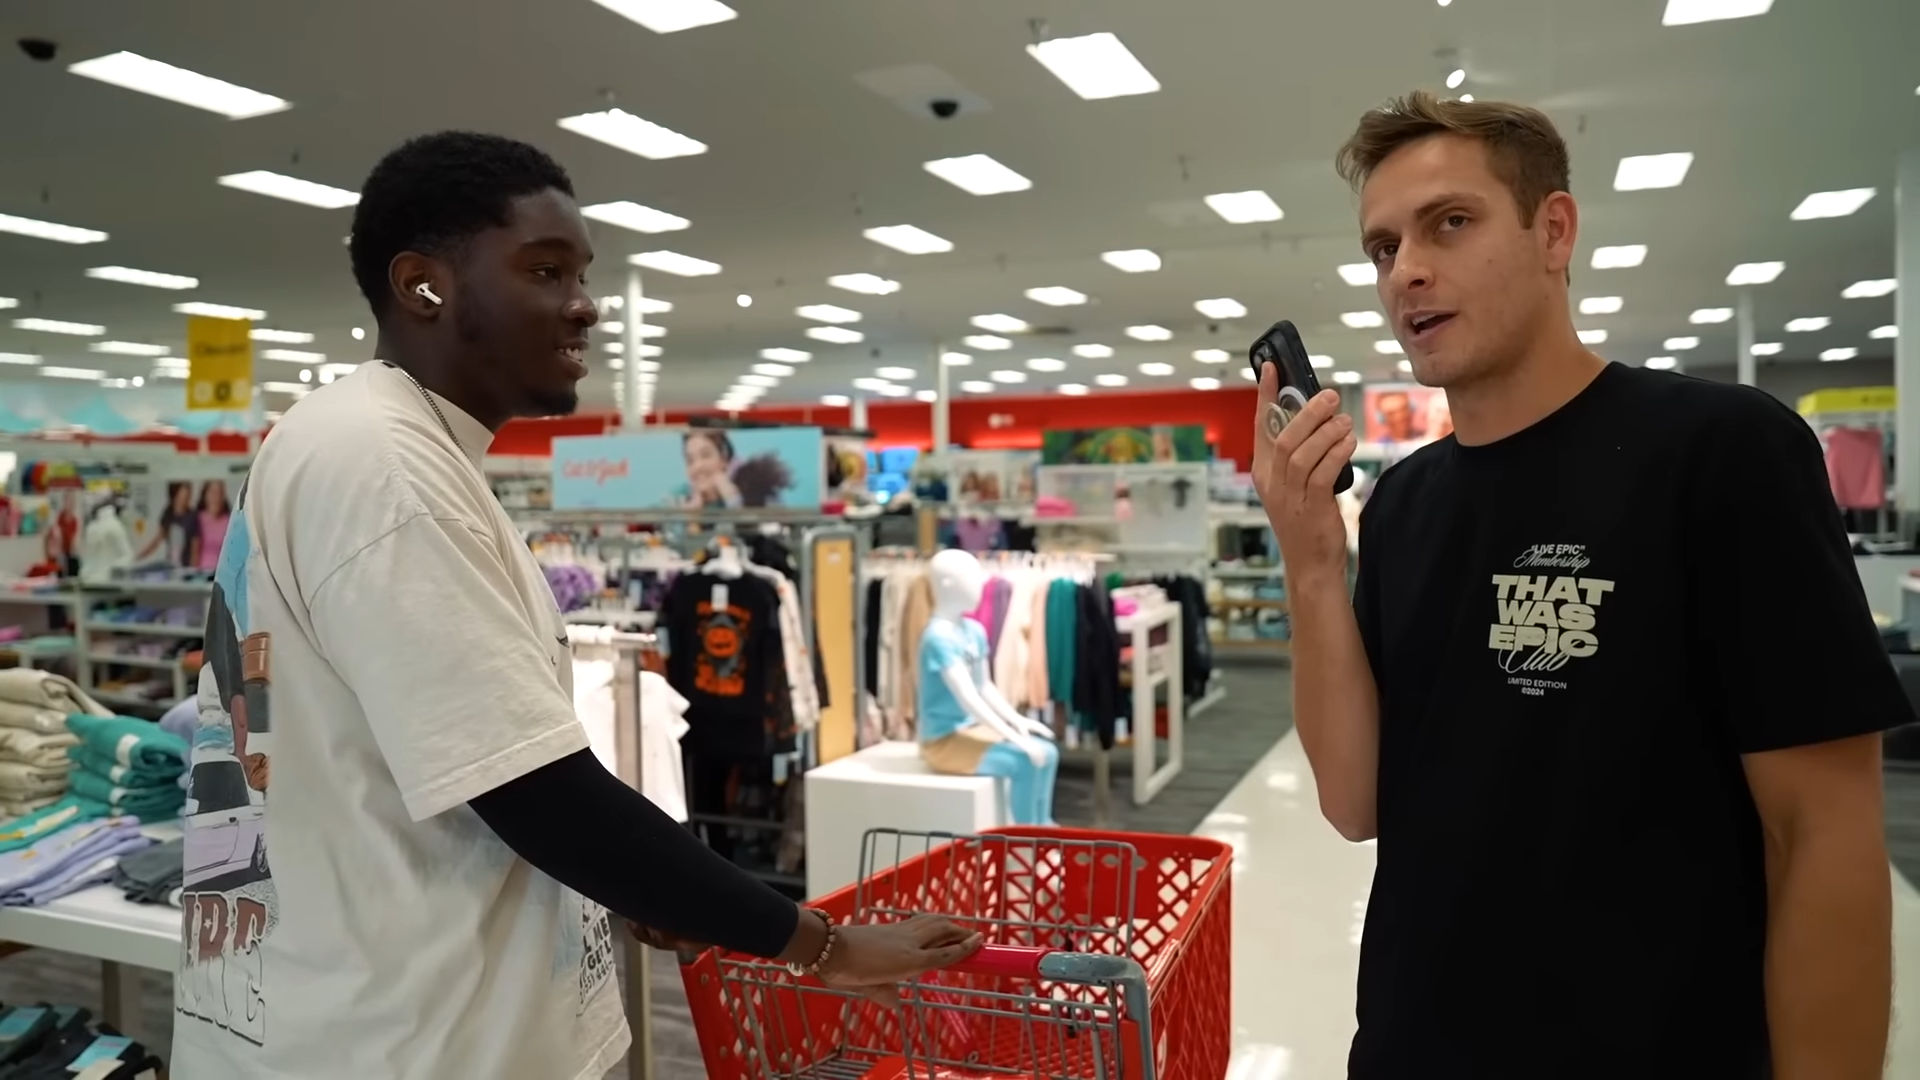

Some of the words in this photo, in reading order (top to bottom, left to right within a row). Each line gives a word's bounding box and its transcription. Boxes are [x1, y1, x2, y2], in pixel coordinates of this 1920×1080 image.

[1513, 548, 1591, 575] Membership
[1491, 574, 1615, 606] THAT
[1497, 599, 1596, 632] WAS
[1488, 623, 1599, 658] EPIC
[1498, 640, 1574, 674] Club
[1507, 677, 1533, 687] LIMITED
[1533, 679, 1568, 690] EDITION
